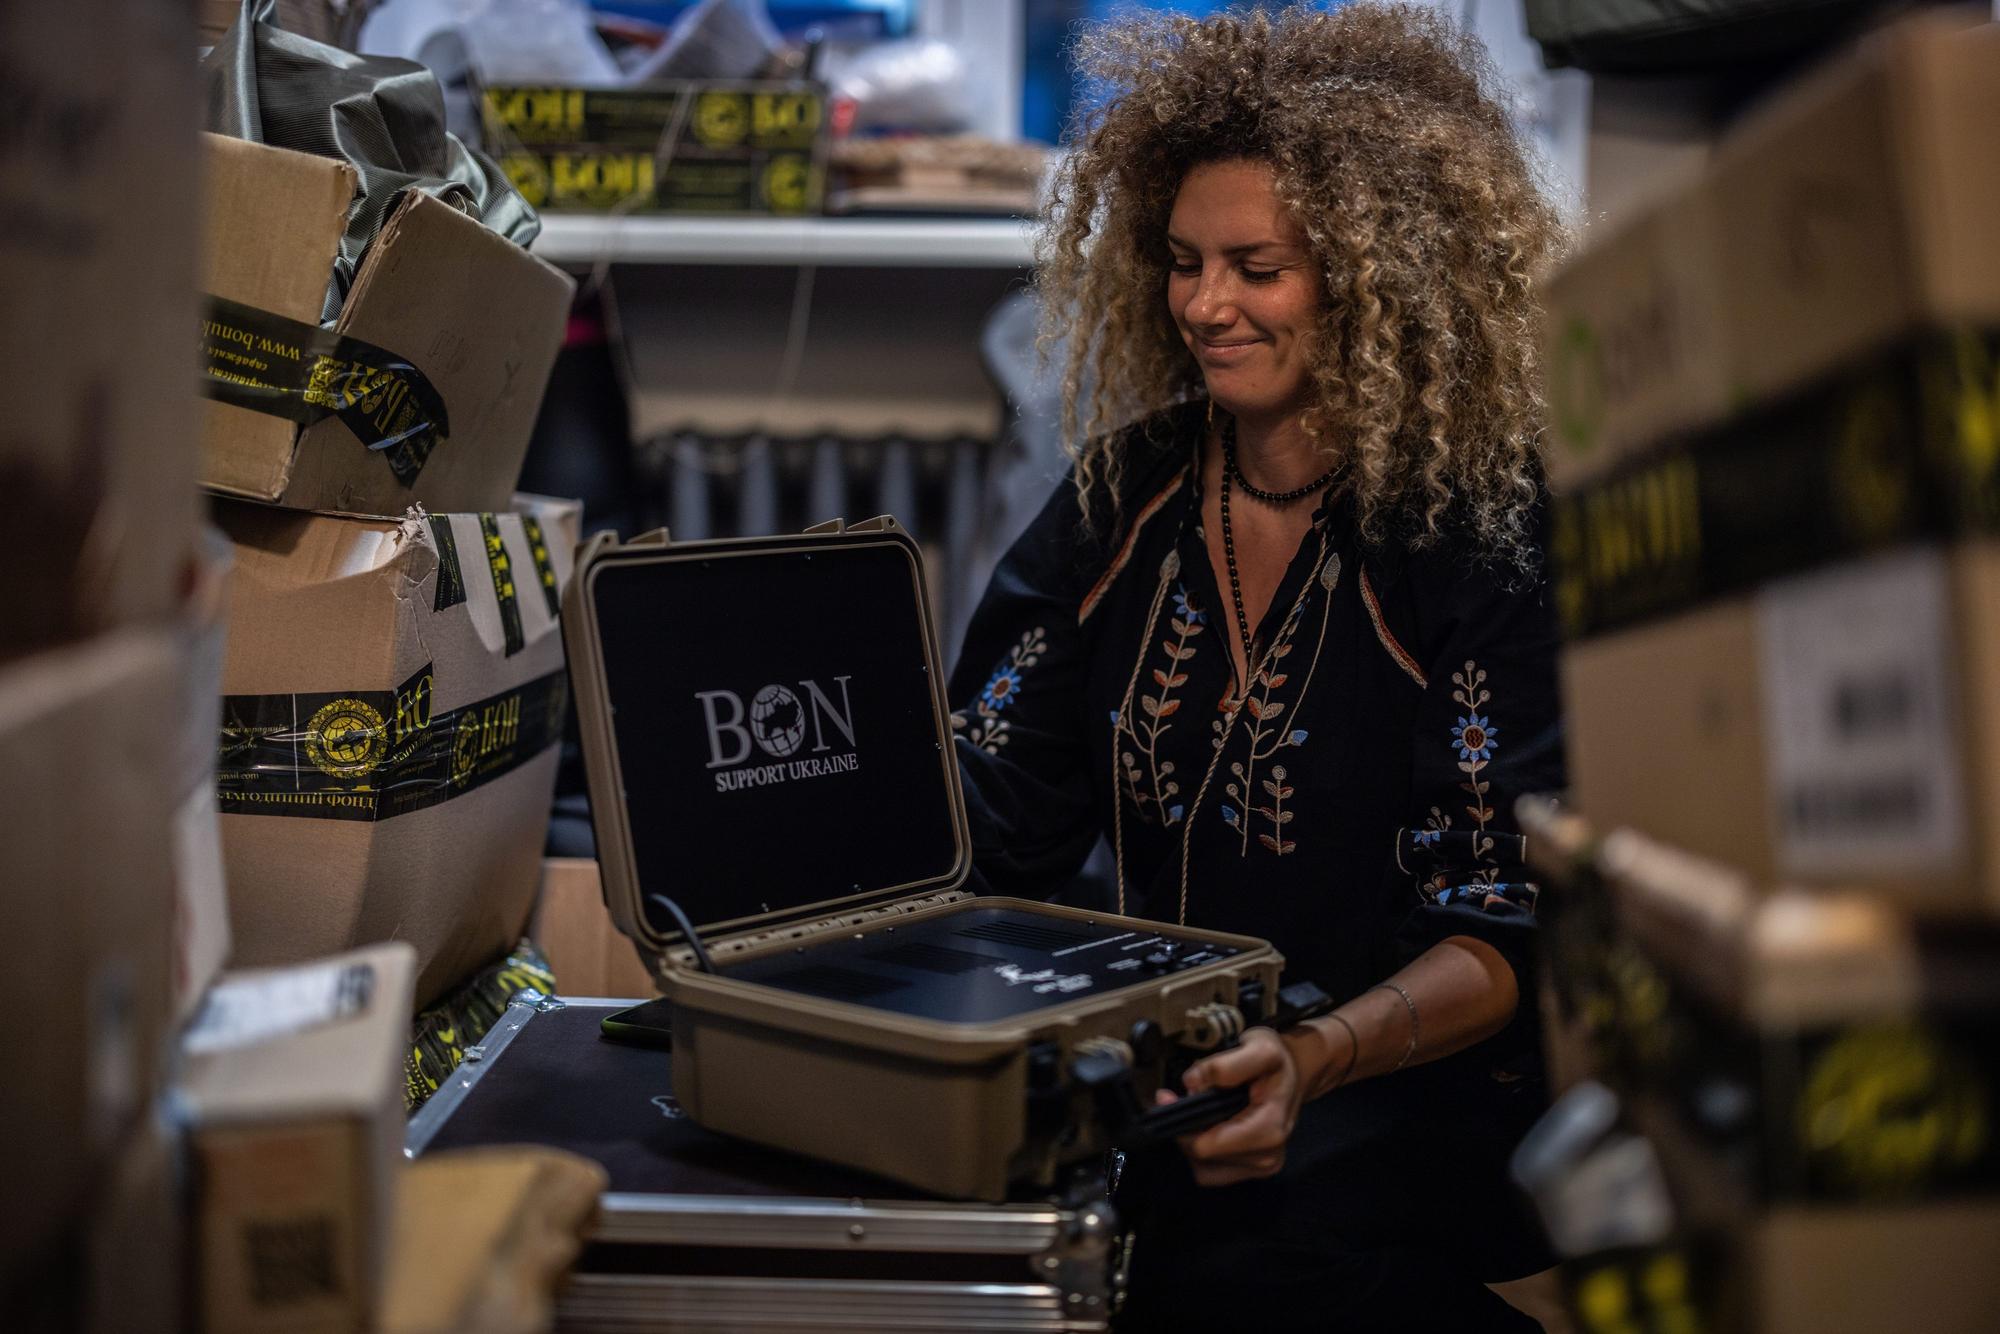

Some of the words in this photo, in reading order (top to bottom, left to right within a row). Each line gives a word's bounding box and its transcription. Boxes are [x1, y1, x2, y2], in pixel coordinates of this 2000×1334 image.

[694, 675, 857, 769] BON
[714, 763, 787, 792] SUPPORT
[788, 753, 859, 780] UKRAINE
[327, 793, 374, 809] ФОНД
